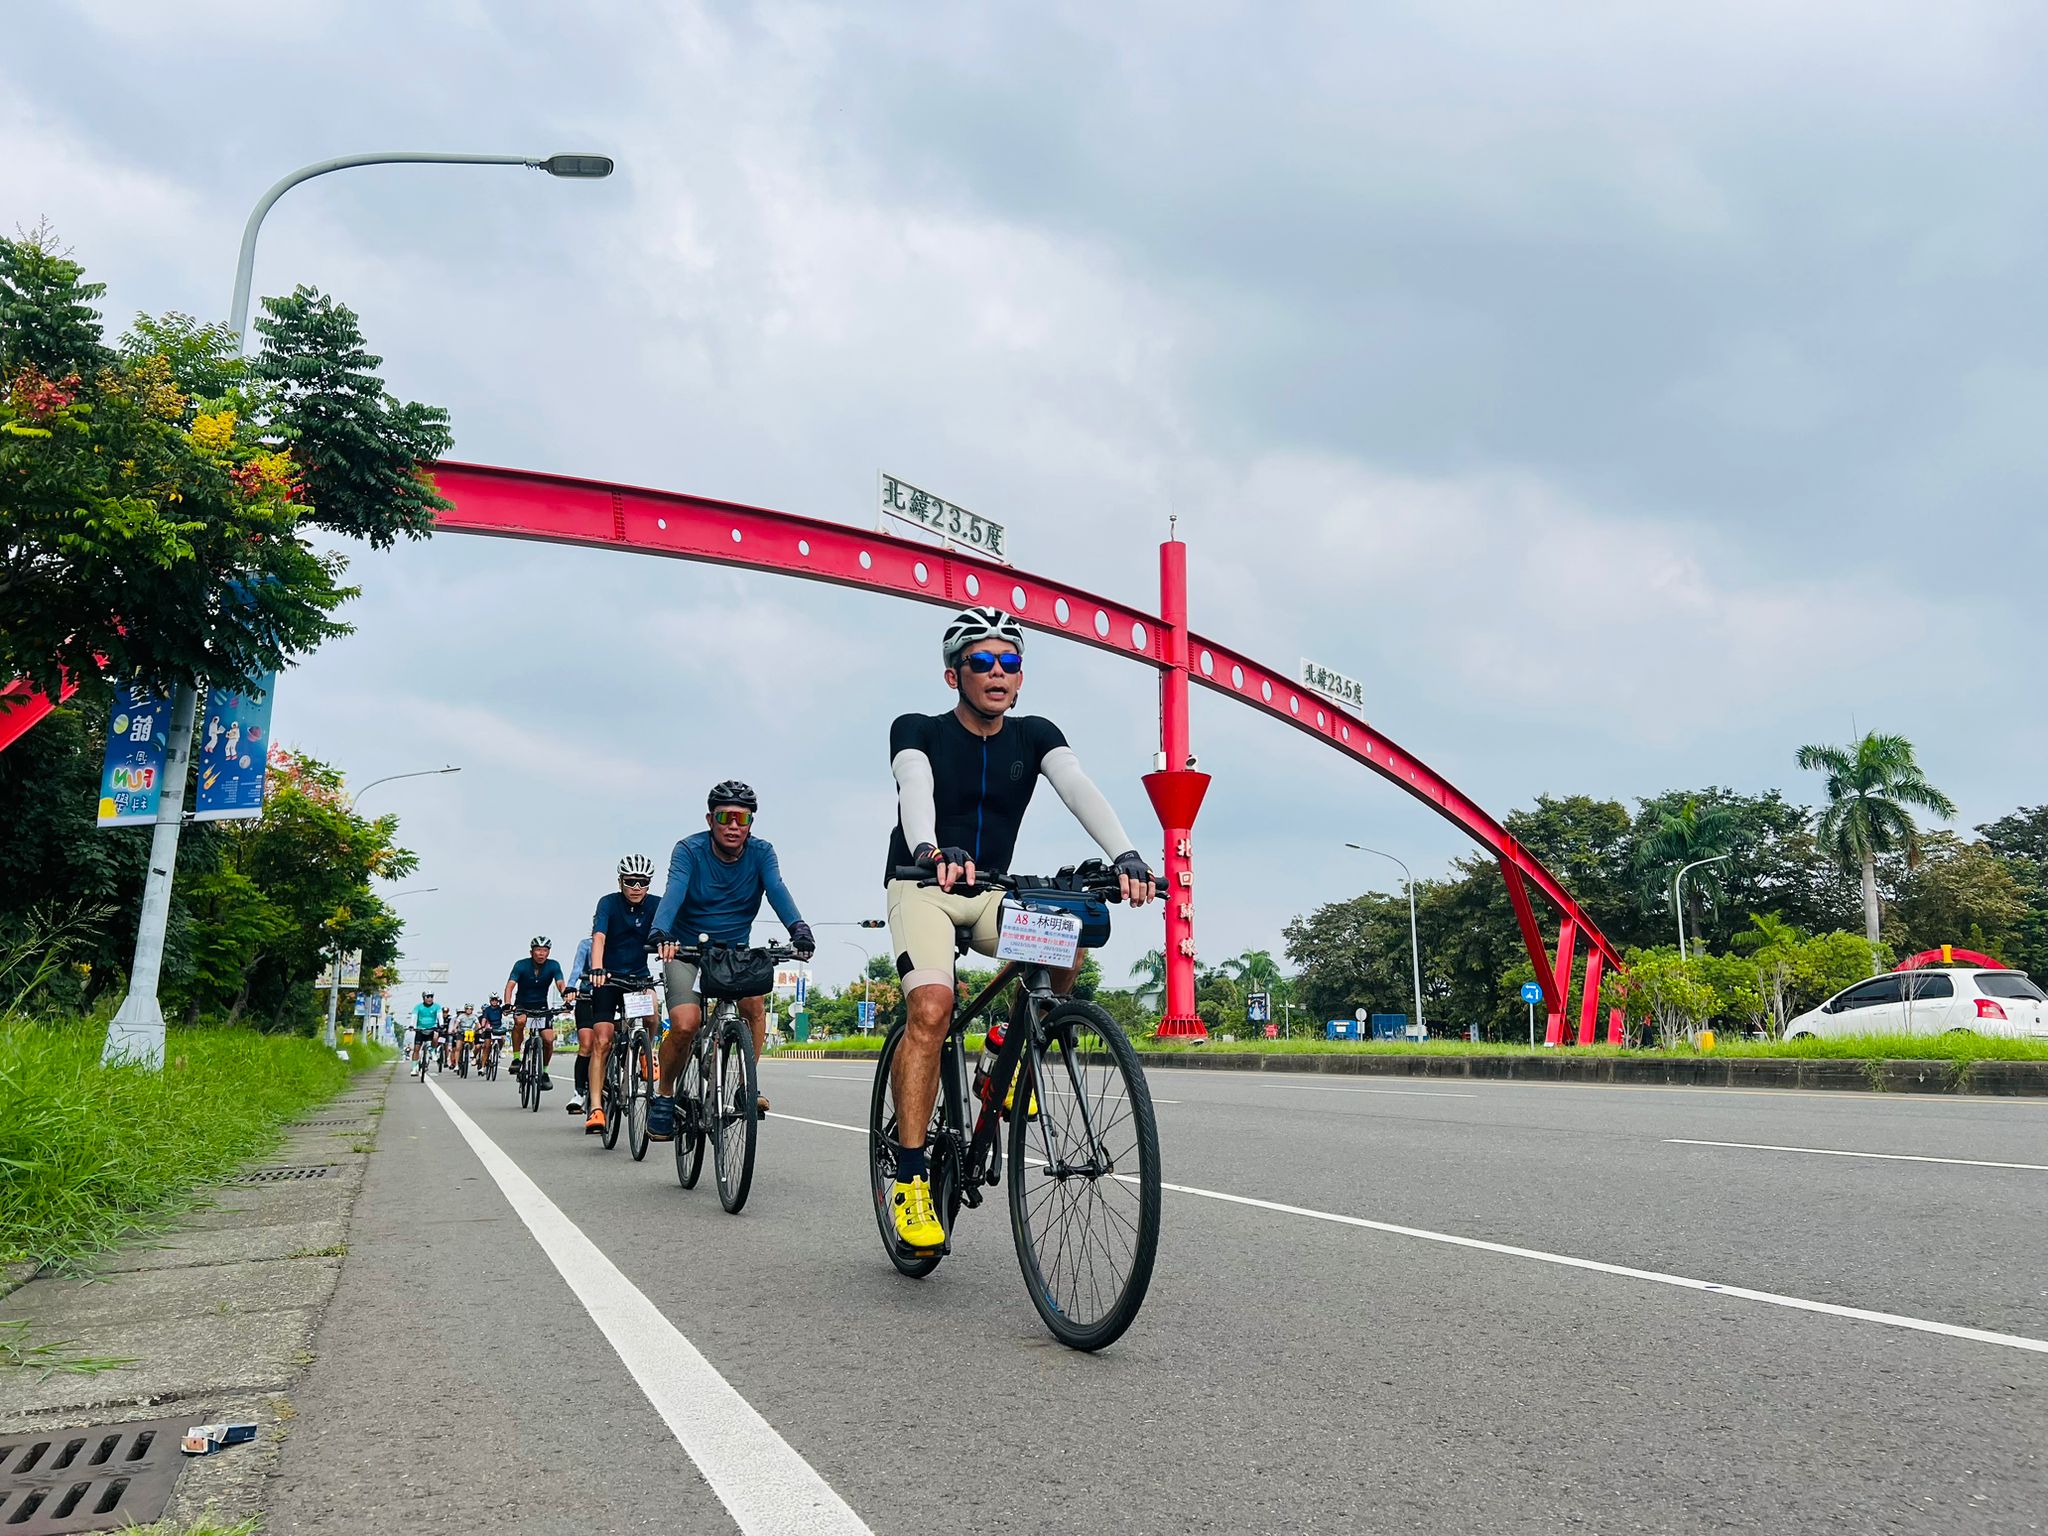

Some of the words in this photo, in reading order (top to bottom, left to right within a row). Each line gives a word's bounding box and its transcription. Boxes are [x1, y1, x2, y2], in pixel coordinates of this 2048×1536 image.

[882, 480, 1004, 556] 北緯23.5度
[1305, 663, 1364, 705] 北緯23.5度
[1177, 838, 1196, 957] 北回歸線
